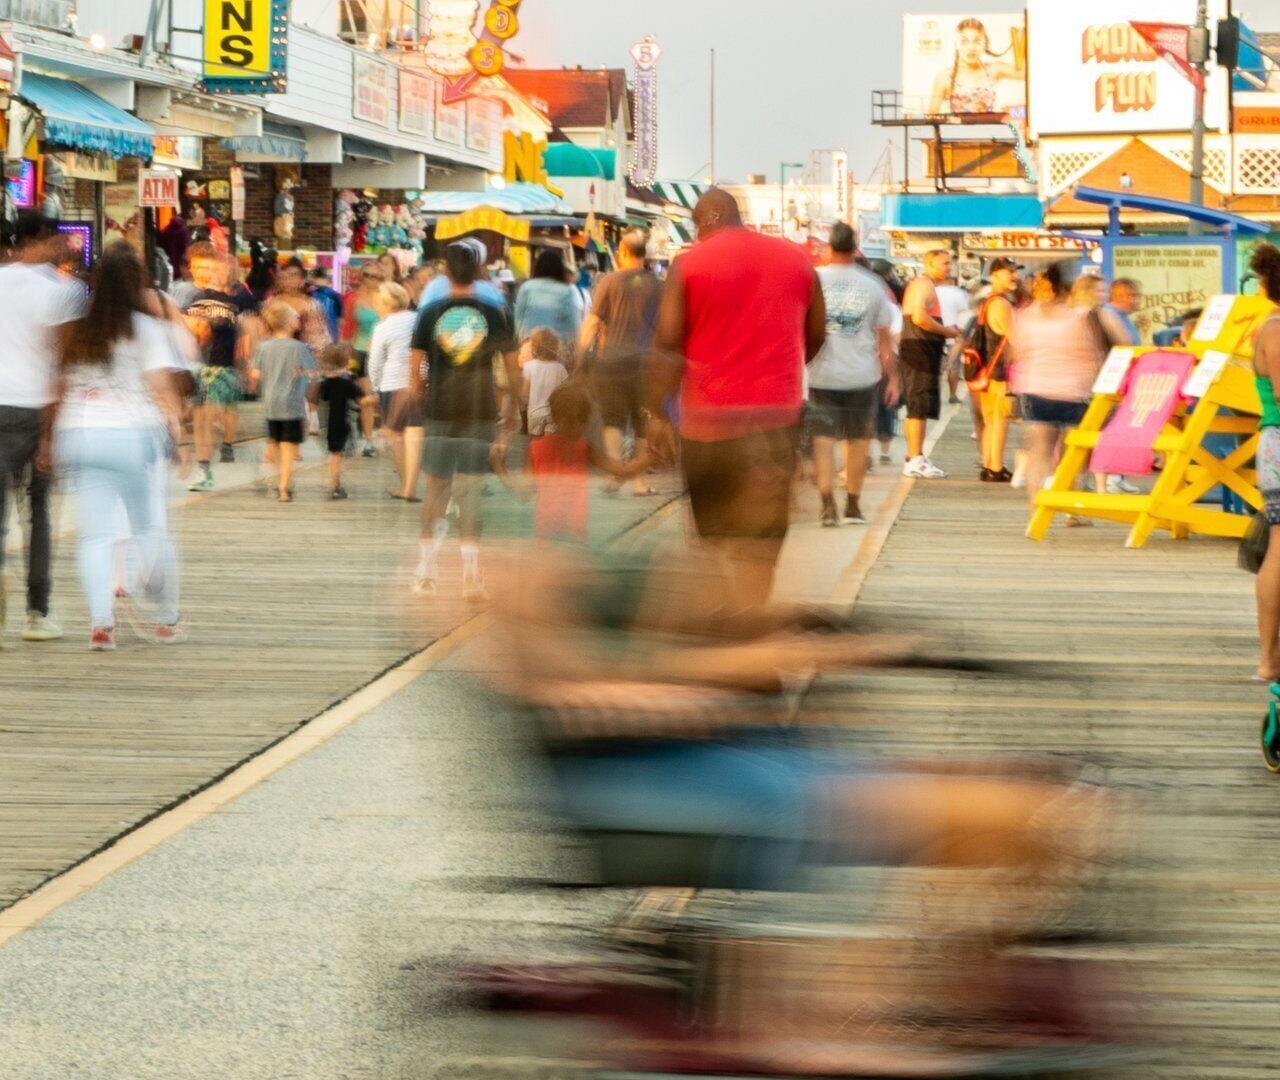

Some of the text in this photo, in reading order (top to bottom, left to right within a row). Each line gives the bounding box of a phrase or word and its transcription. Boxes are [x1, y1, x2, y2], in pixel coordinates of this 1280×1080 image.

[1095, 71, 1156, 113] FUN
[142, 178, 175, 199] ATM
[1001, 231, 1042, 248] HOT
